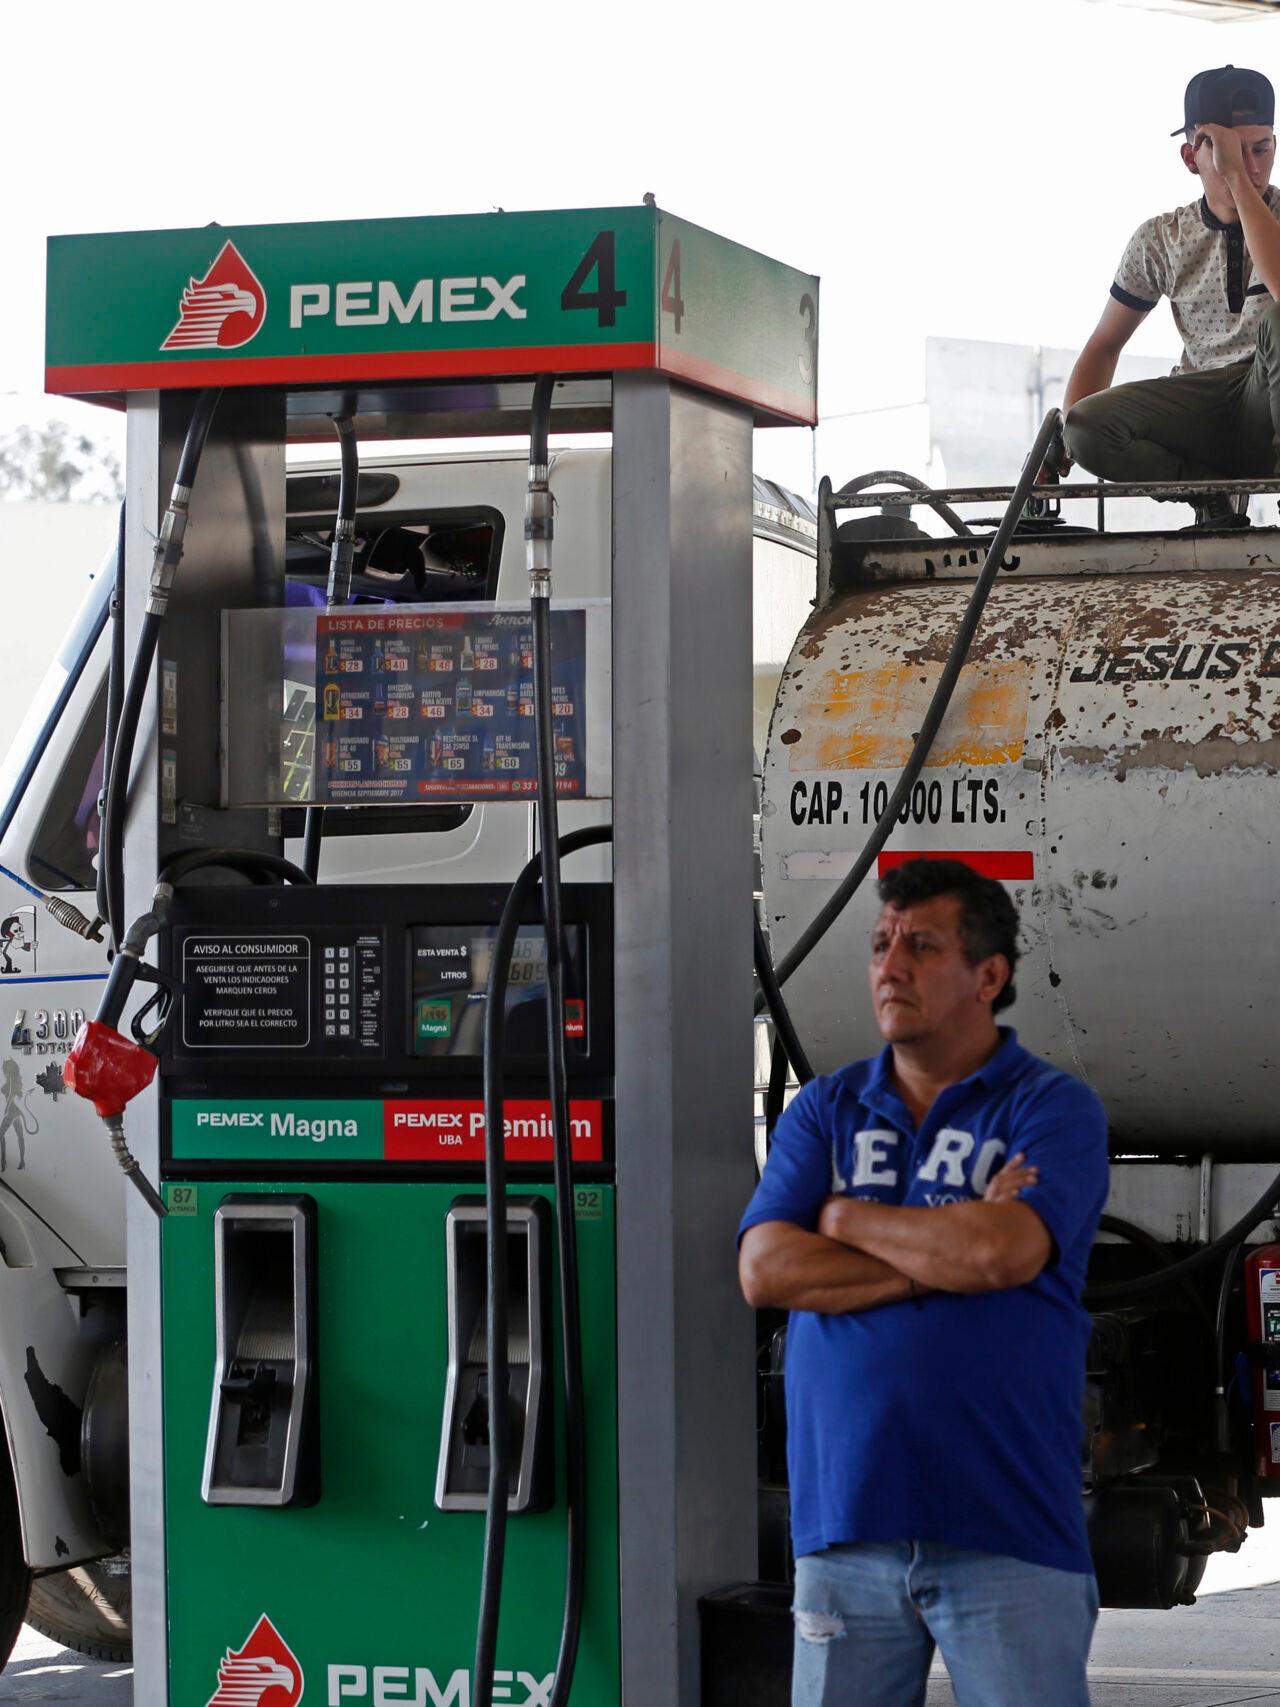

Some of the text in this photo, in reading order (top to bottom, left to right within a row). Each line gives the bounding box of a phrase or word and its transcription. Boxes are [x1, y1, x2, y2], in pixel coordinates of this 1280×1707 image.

[560, 230, 627, 328] 4
[661, 238, 684, 334] 4
[289, 275, 527, 328] PEMEX
[328, 618, 444, 630] LISTA DE PRECIOS
[790, 780, 848, 825] CAP.
[951, 779, 1006, 823] LTS.
[193, 944, 298, 954] AVISO AL CONSUMIDOR
[460, 945, 467, 957] $
[196, 965, 298, 974] ASEGURESE QUE ANTES DE LA
[440, 971, 467, 979] LITROS
[204, 976, 289, 984] VENTA LOS INDICADORES
[216, 987, 277, 995] MARQUEN CEROS
[204, 1009, 240, 1017] VERIFIQUE
[241, 1009, 256, 1017] QUE
[11, 1007, 86, 1050] 4300
[421, 1024, 447, 1033] Magna
[197, 1112, 358, 1142] PEMEX Magna
[394, 1112, 592, 1138] PEMEX Pemim
[438, 1134, 462, 1145] UBA
[172, 1188, 193, 1204] 87
[577, 1192, 598, 1207] 92
